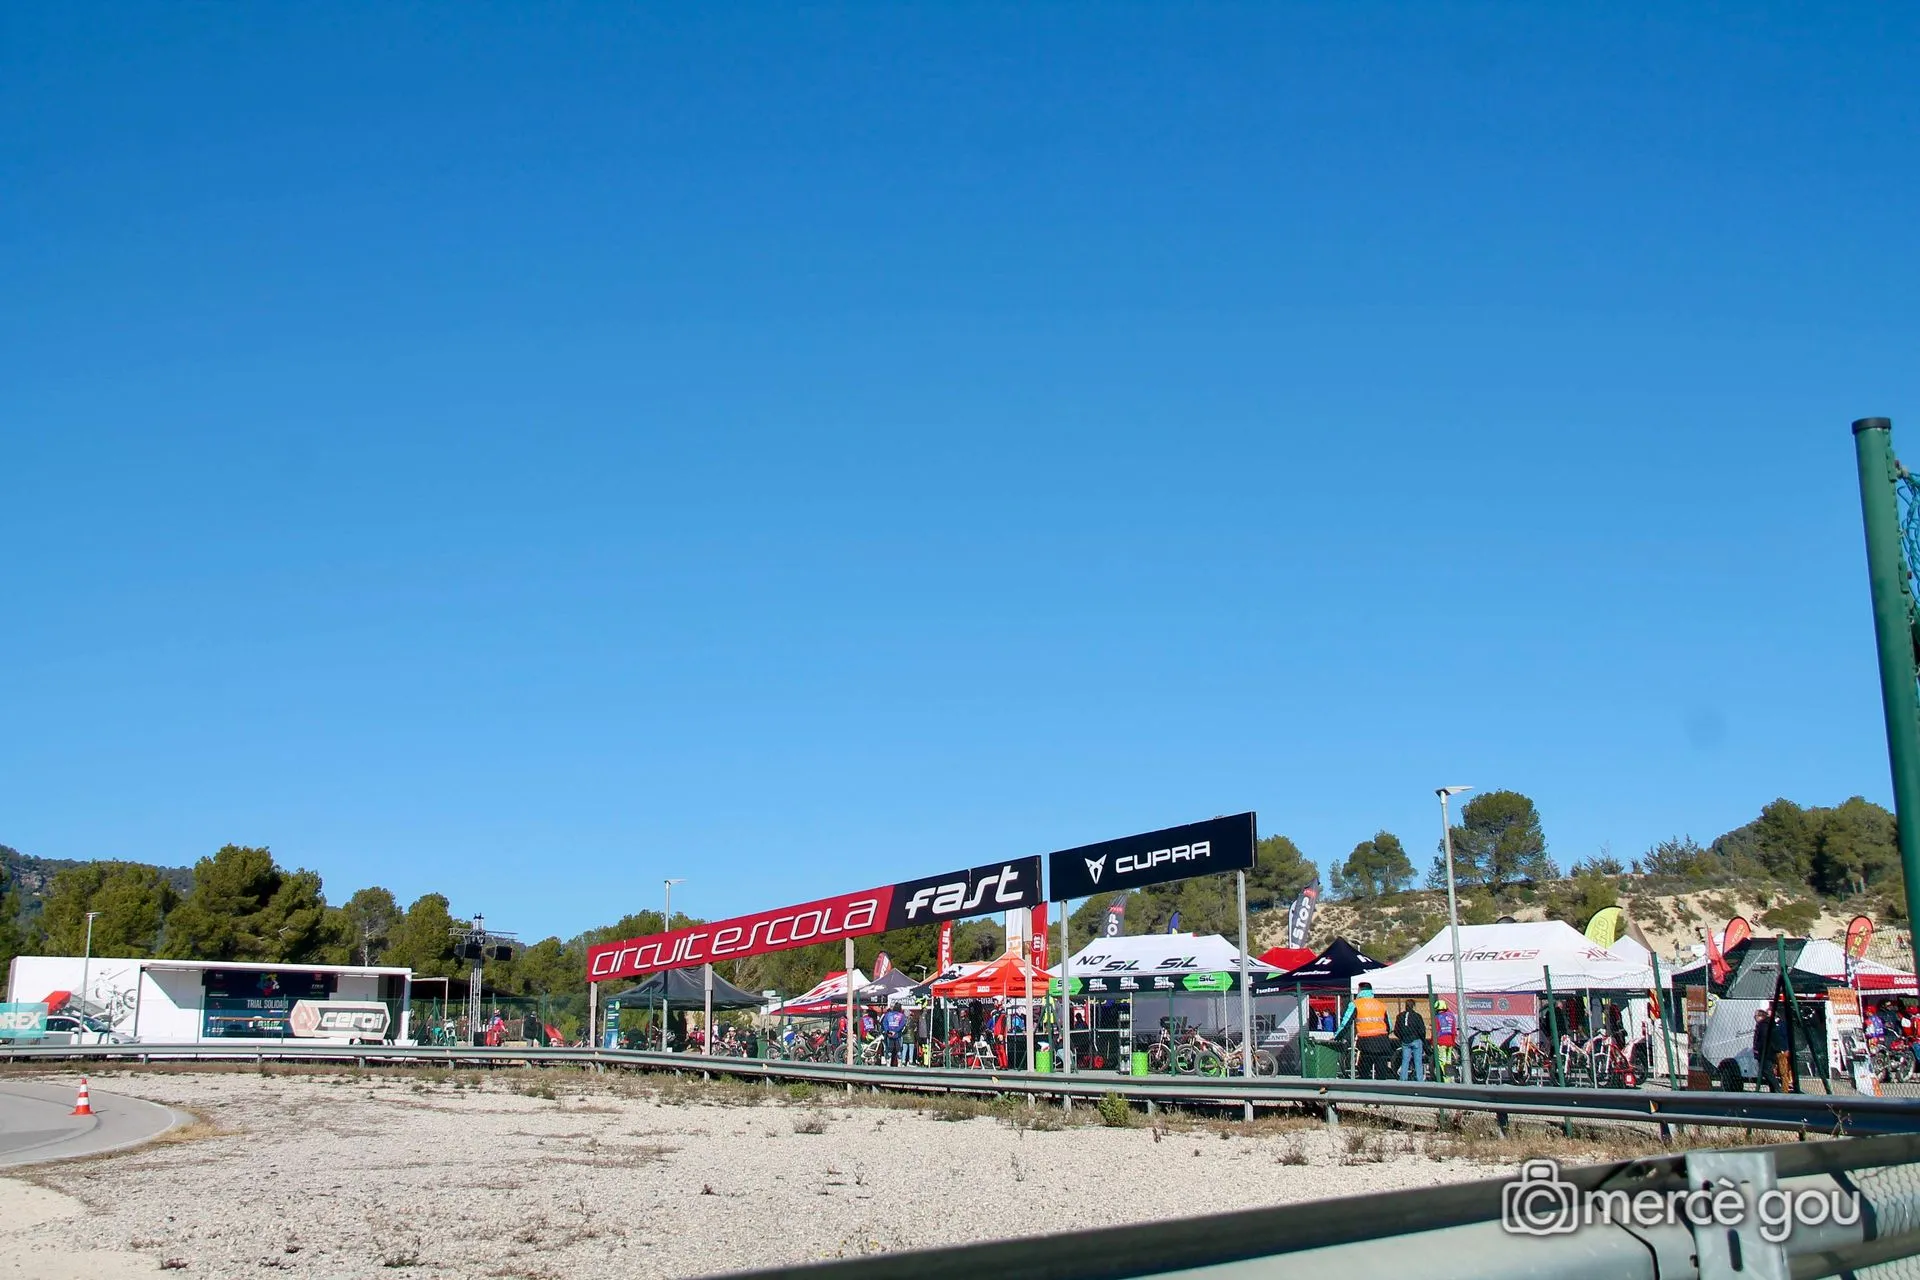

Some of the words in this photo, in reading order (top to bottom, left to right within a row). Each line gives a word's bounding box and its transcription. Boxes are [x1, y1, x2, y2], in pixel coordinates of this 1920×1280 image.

[1115, 840, 1211, 874] CUPRA
[592, 933, 708, 976] circuit
[711, 898, 878, 955] escola
[905, 865, 1023, 919] fast
[1292, 896, 1311, 940] STOP
[941, 927, 951, 971] OTUL
[247, 1000, 263, 1009] TRIAL
